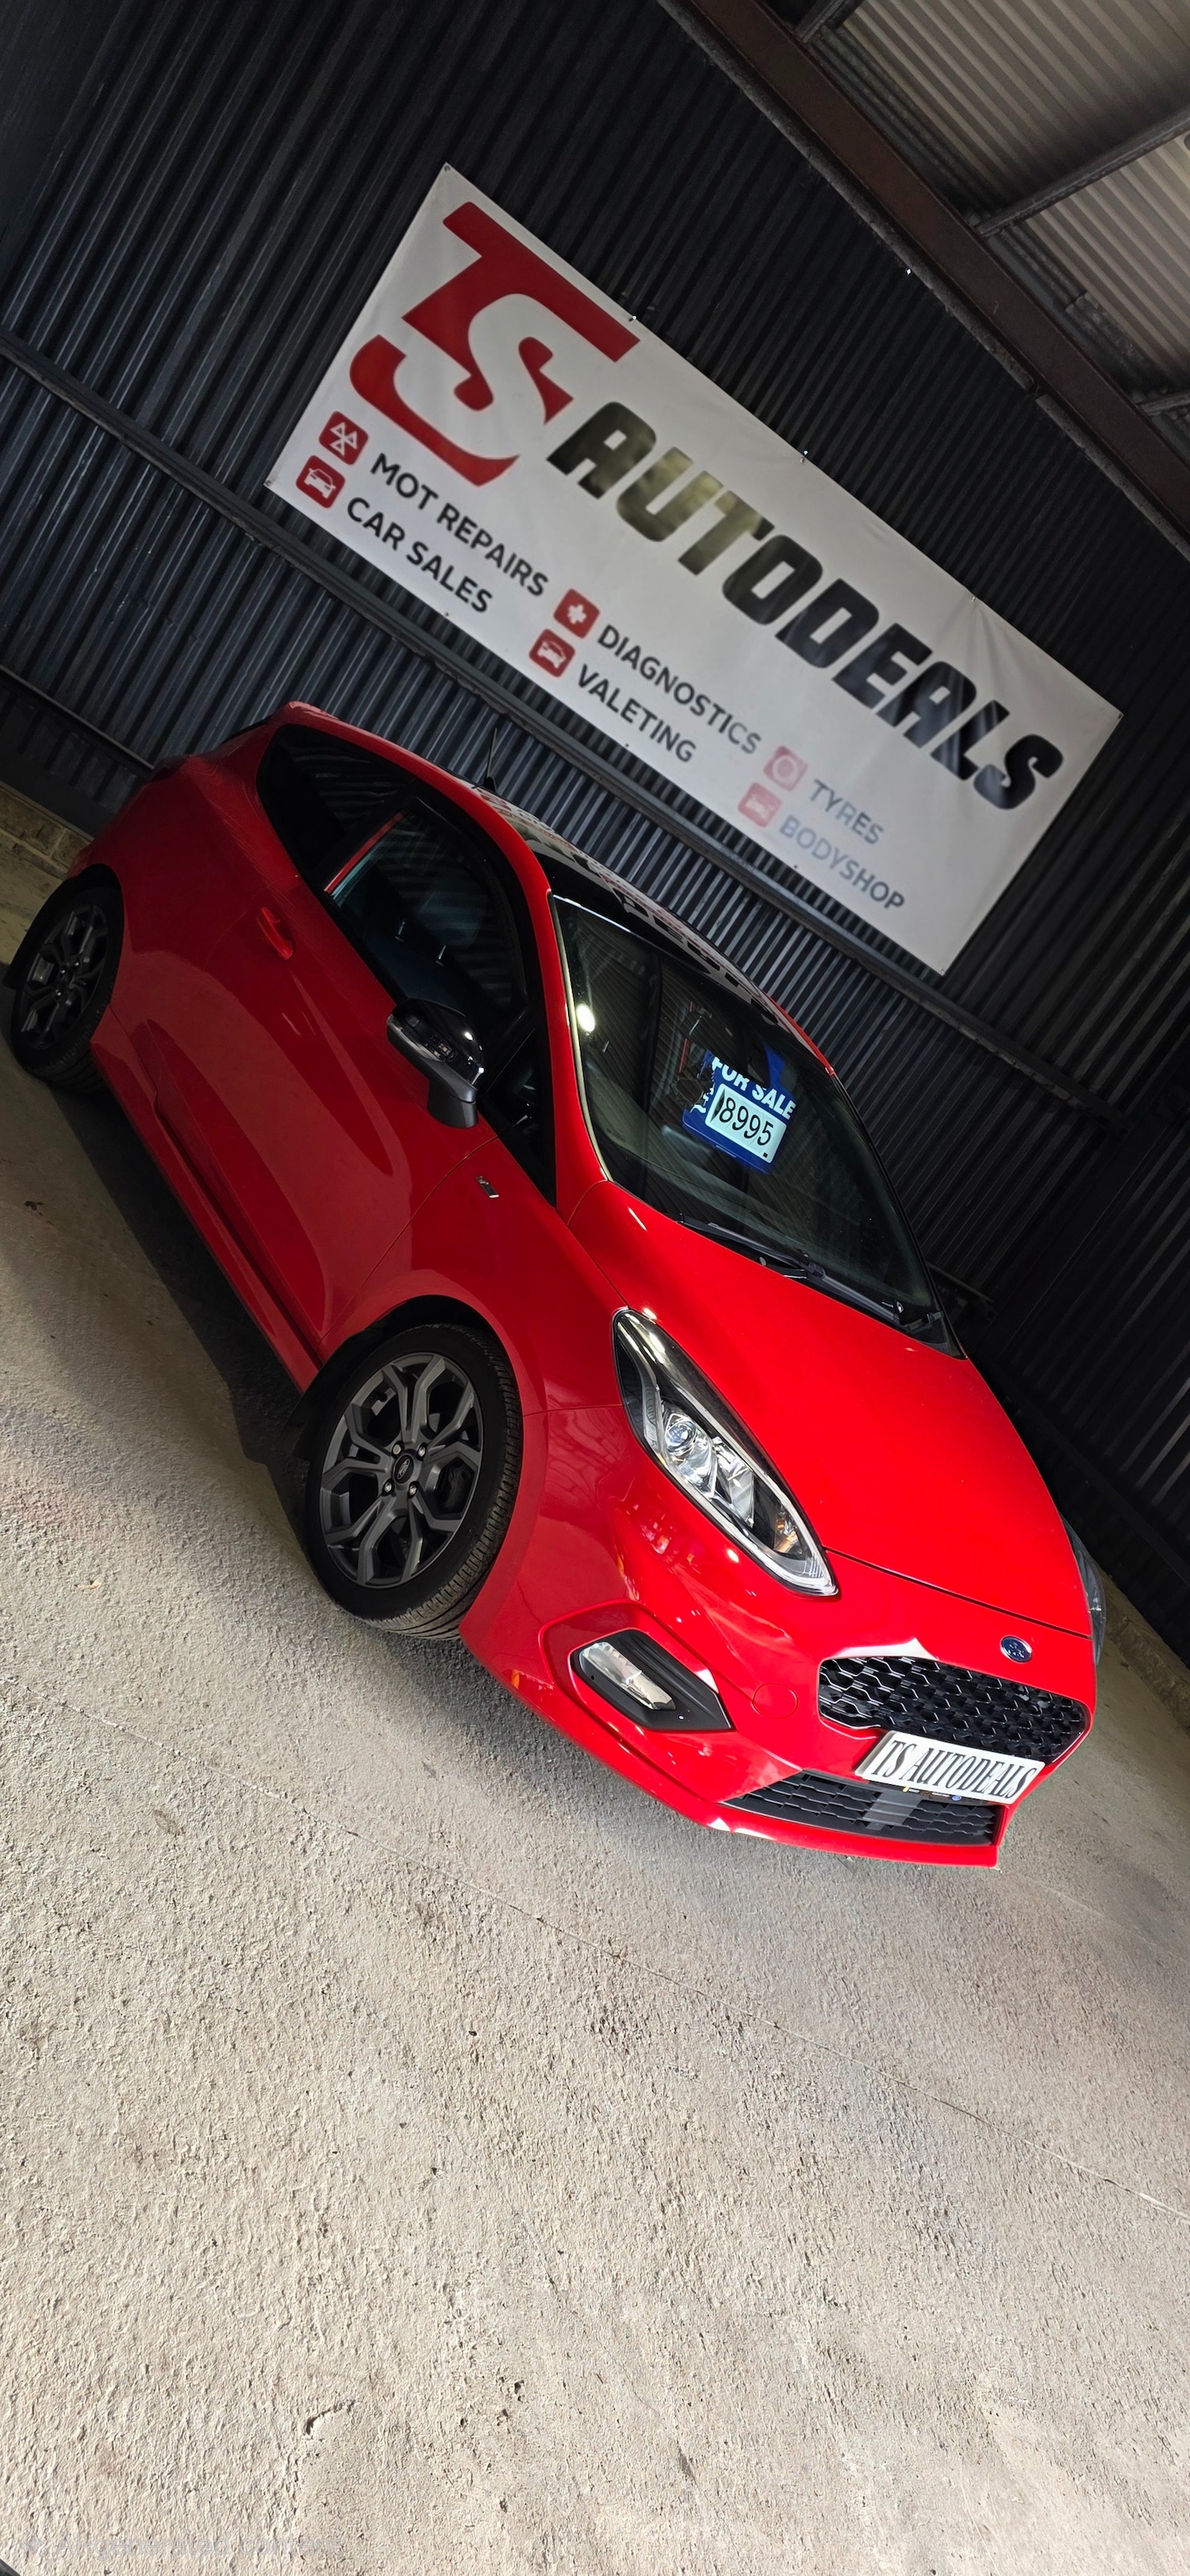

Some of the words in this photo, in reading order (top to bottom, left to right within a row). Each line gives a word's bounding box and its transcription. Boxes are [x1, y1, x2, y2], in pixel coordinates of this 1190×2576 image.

[347, 497, 406, 551] CAR
[405, 540, 493, 613] SALES
[349, 201, 641, 486] TS
[545, 401, 1064, 811] AUTODEALS
[370, 452, 439, 511] MOT
[436, 502, 549, 597] REPAIRS
[577, 664, 697, 763] VALETING
[597, 624, 762, 755] DIAGNOSTICS
[808, 778, 885, 846] TYRES
[778, 814, 906, 911] BODYSHOP
[751, 1084, 797, 1120] SALE
[870, 1739, 918, 1779] TS
[898, 1747, 1038, 1799] AUTODEALS
